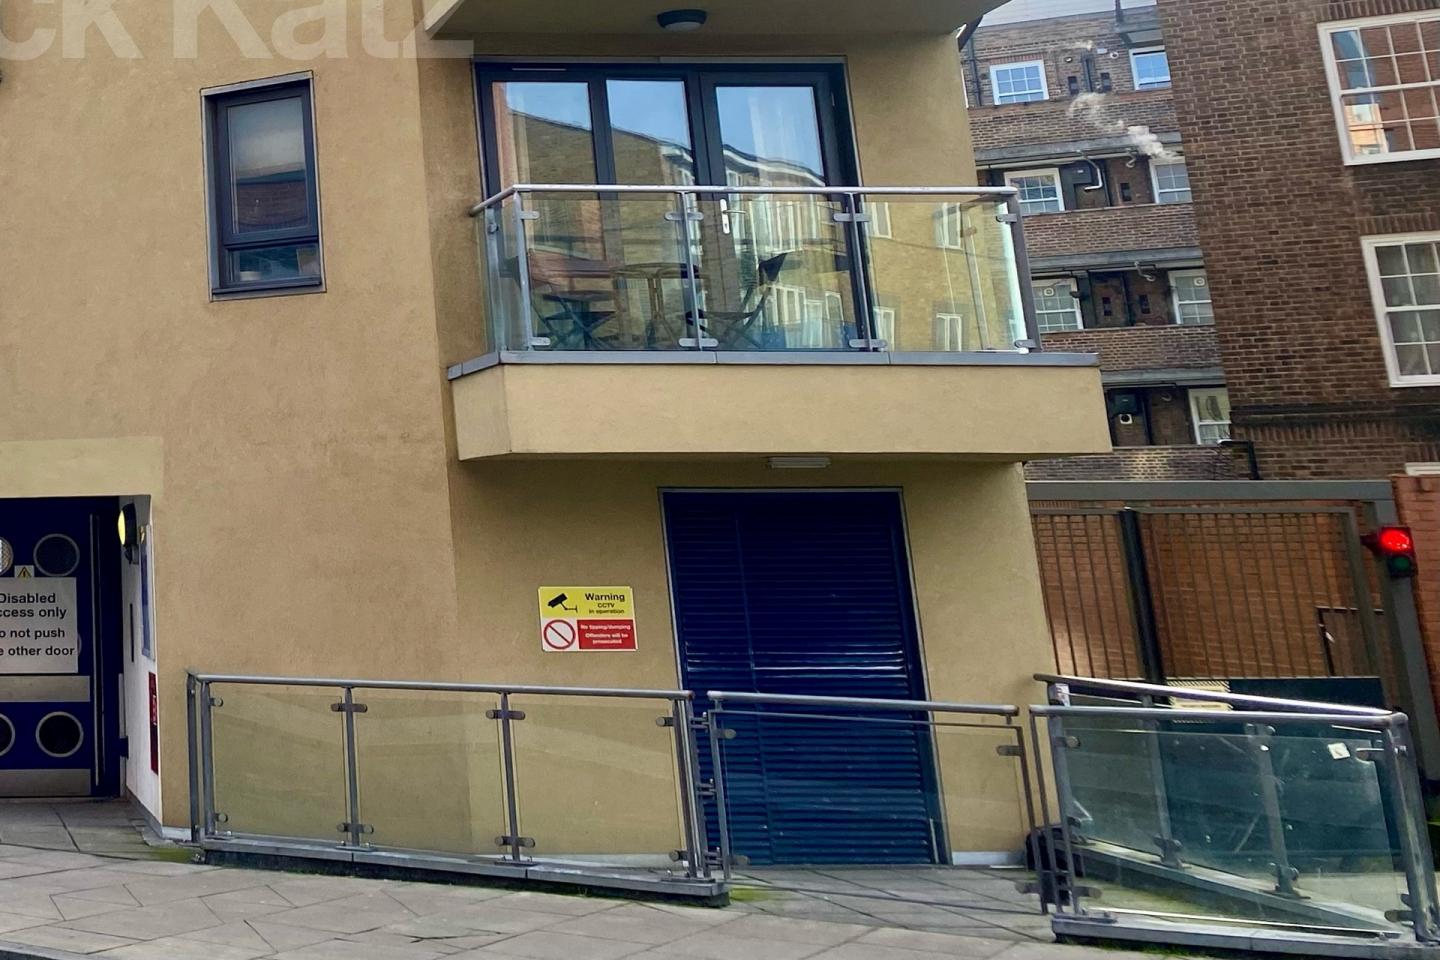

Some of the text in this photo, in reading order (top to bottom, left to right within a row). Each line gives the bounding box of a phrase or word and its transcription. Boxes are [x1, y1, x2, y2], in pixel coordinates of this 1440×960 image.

[584, 592, 625, 602] Warning
[38, 606, 67, 620] only
[9, 627, 31, 638] not
[34, 626, 66, 641] push
[7, 645, 42, 656] other
[44, 645, 76, 656] door
